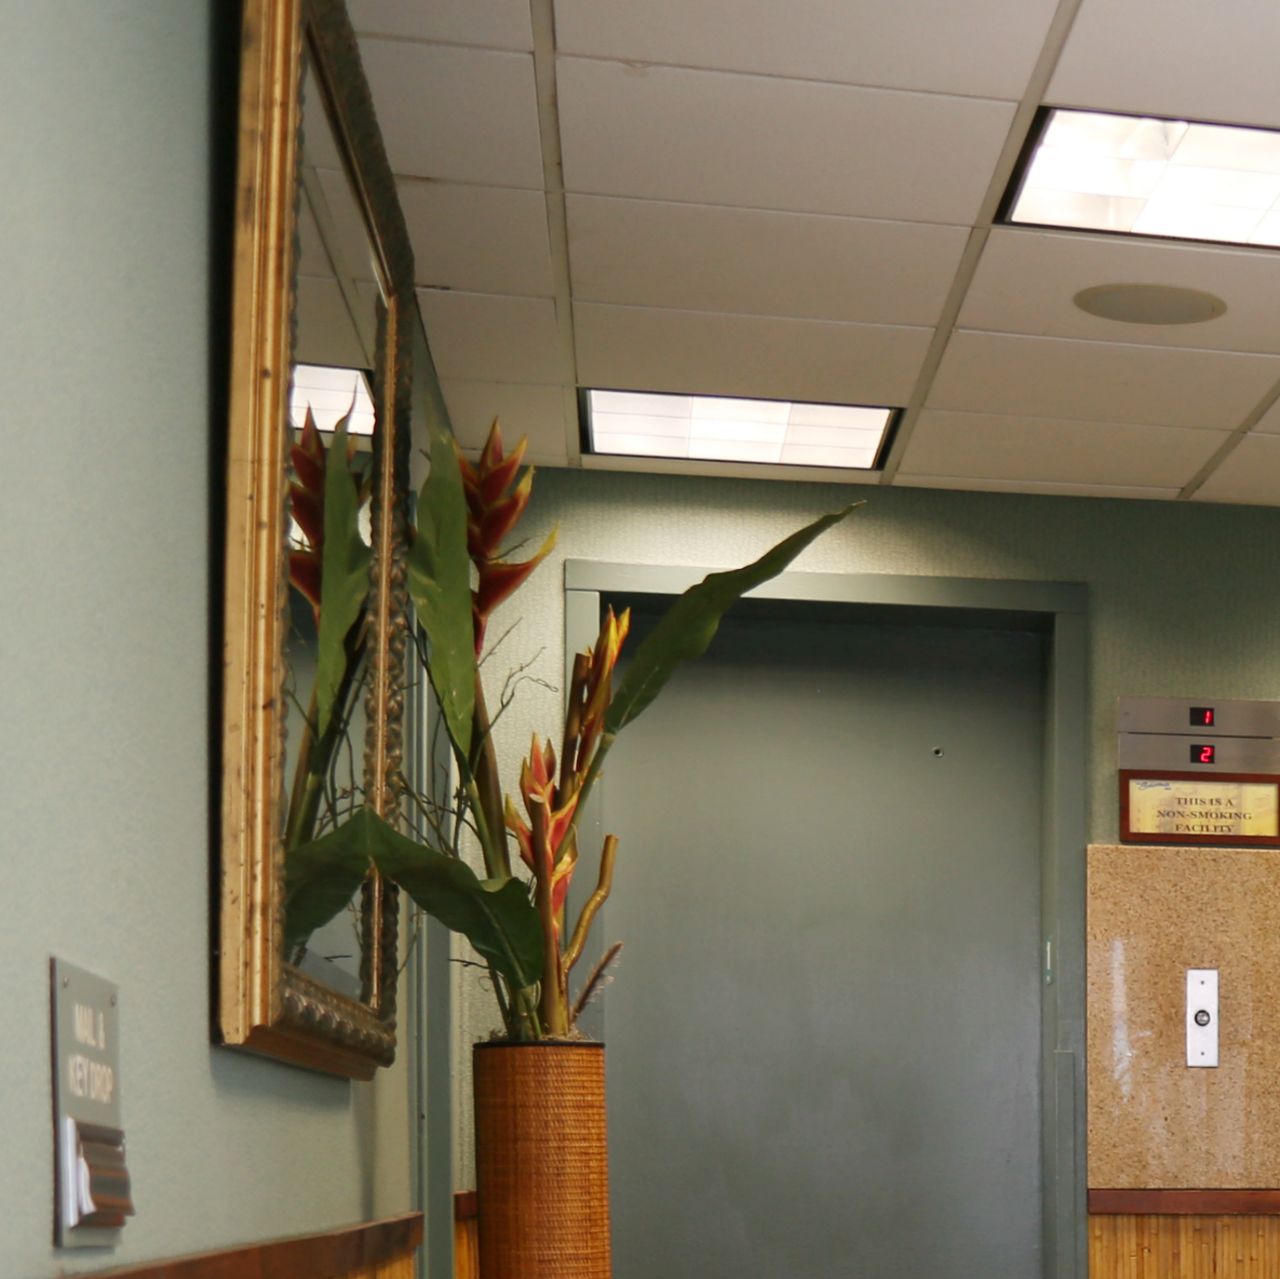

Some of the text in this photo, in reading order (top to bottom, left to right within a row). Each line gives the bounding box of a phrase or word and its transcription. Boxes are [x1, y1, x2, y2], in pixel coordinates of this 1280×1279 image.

[1204, 711, 1210, 724] 1
[1200, 747, 1212, 762] 2
[1175, 797, 1234, 807] THIS IS A
[1156, 809, 1252, 820] NON-SMOKING
[1175, 823, 1233, 834] FACILITY
[68, 1054, 89, 1097] KEY
